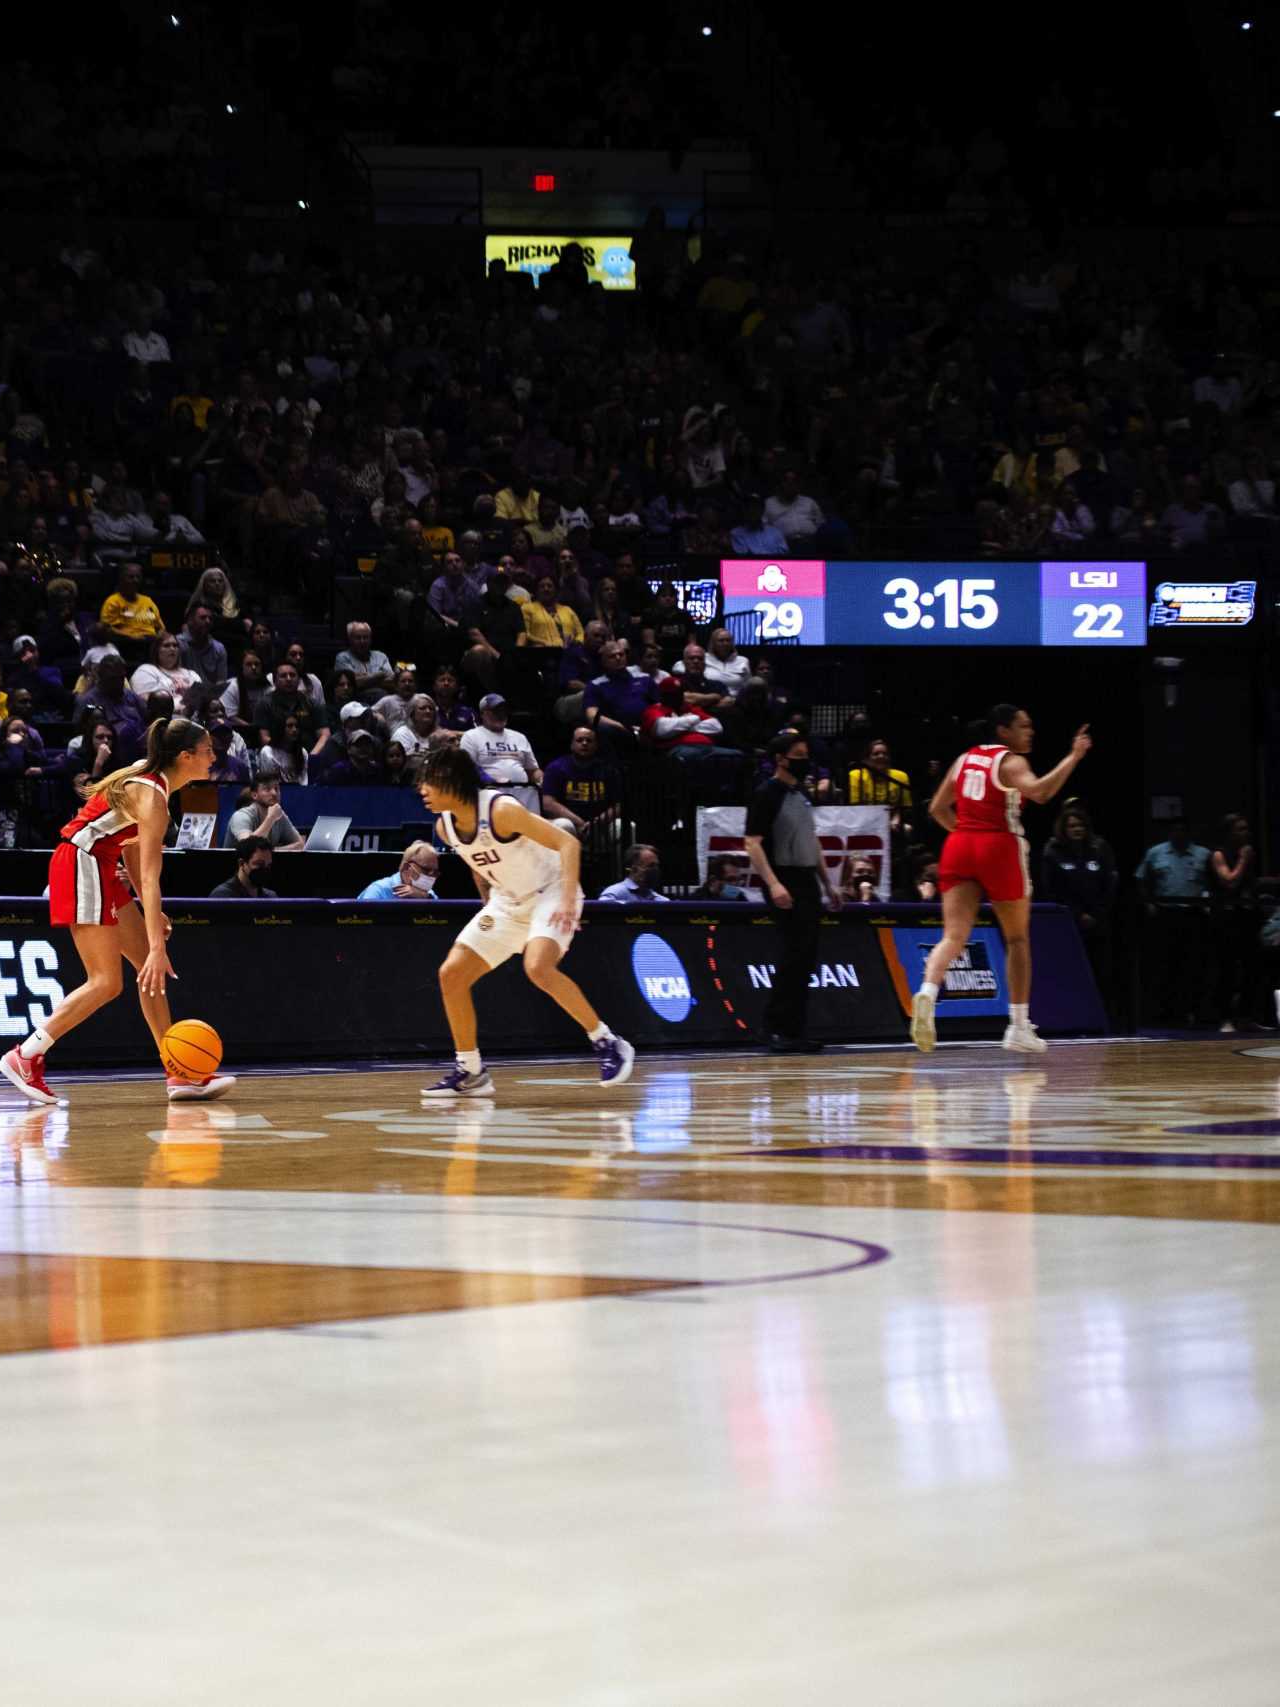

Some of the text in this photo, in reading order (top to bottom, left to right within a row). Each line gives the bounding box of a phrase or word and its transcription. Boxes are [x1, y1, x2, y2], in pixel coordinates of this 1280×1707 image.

[1071, 572, 1117, 587] LSU
[883, 577, 998, 630] 3:15
[754, 602, 803, 637] 29
[1073, 604, 1124, 638] 22
[486, 742, 518, 752] LSU
[566, 779, 606, 802] LSU
[643, 976, 691, 998] NCAA
